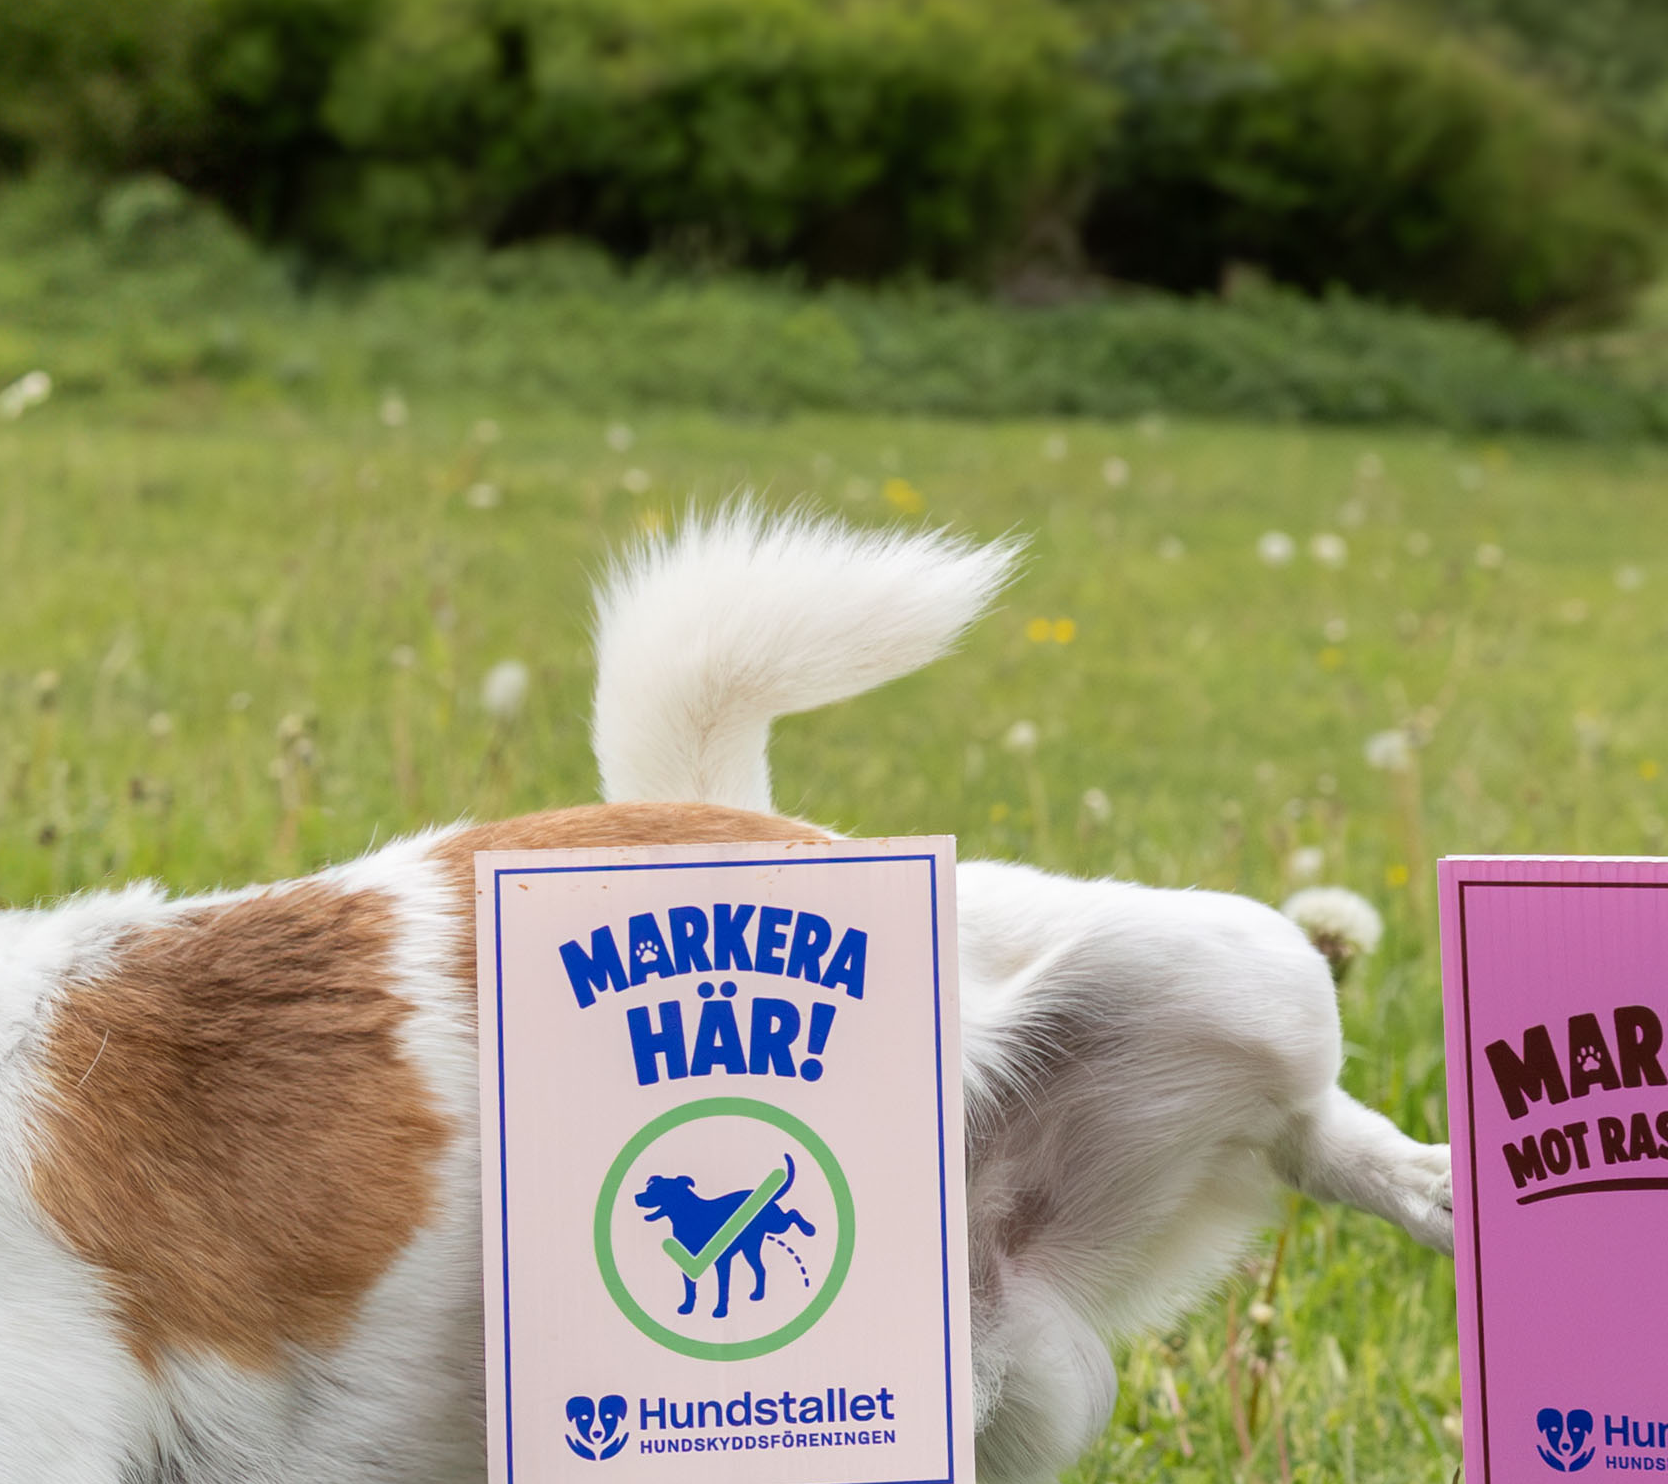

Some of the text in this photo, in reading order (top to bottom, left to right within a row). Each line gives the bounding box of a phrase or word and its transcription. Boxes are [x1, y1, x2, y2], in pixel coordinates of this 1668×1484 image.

[559, 904, 867, 1009] MARKERA
[627, 981, 836, 1086] HÄR!
[1502, 1122, 1590, 1189] MOT
[640, 1388, 894, 1430] Hundstallet
[641, 1430, 895, 1454] HUNDSKYDDSFÖRENINGEN
